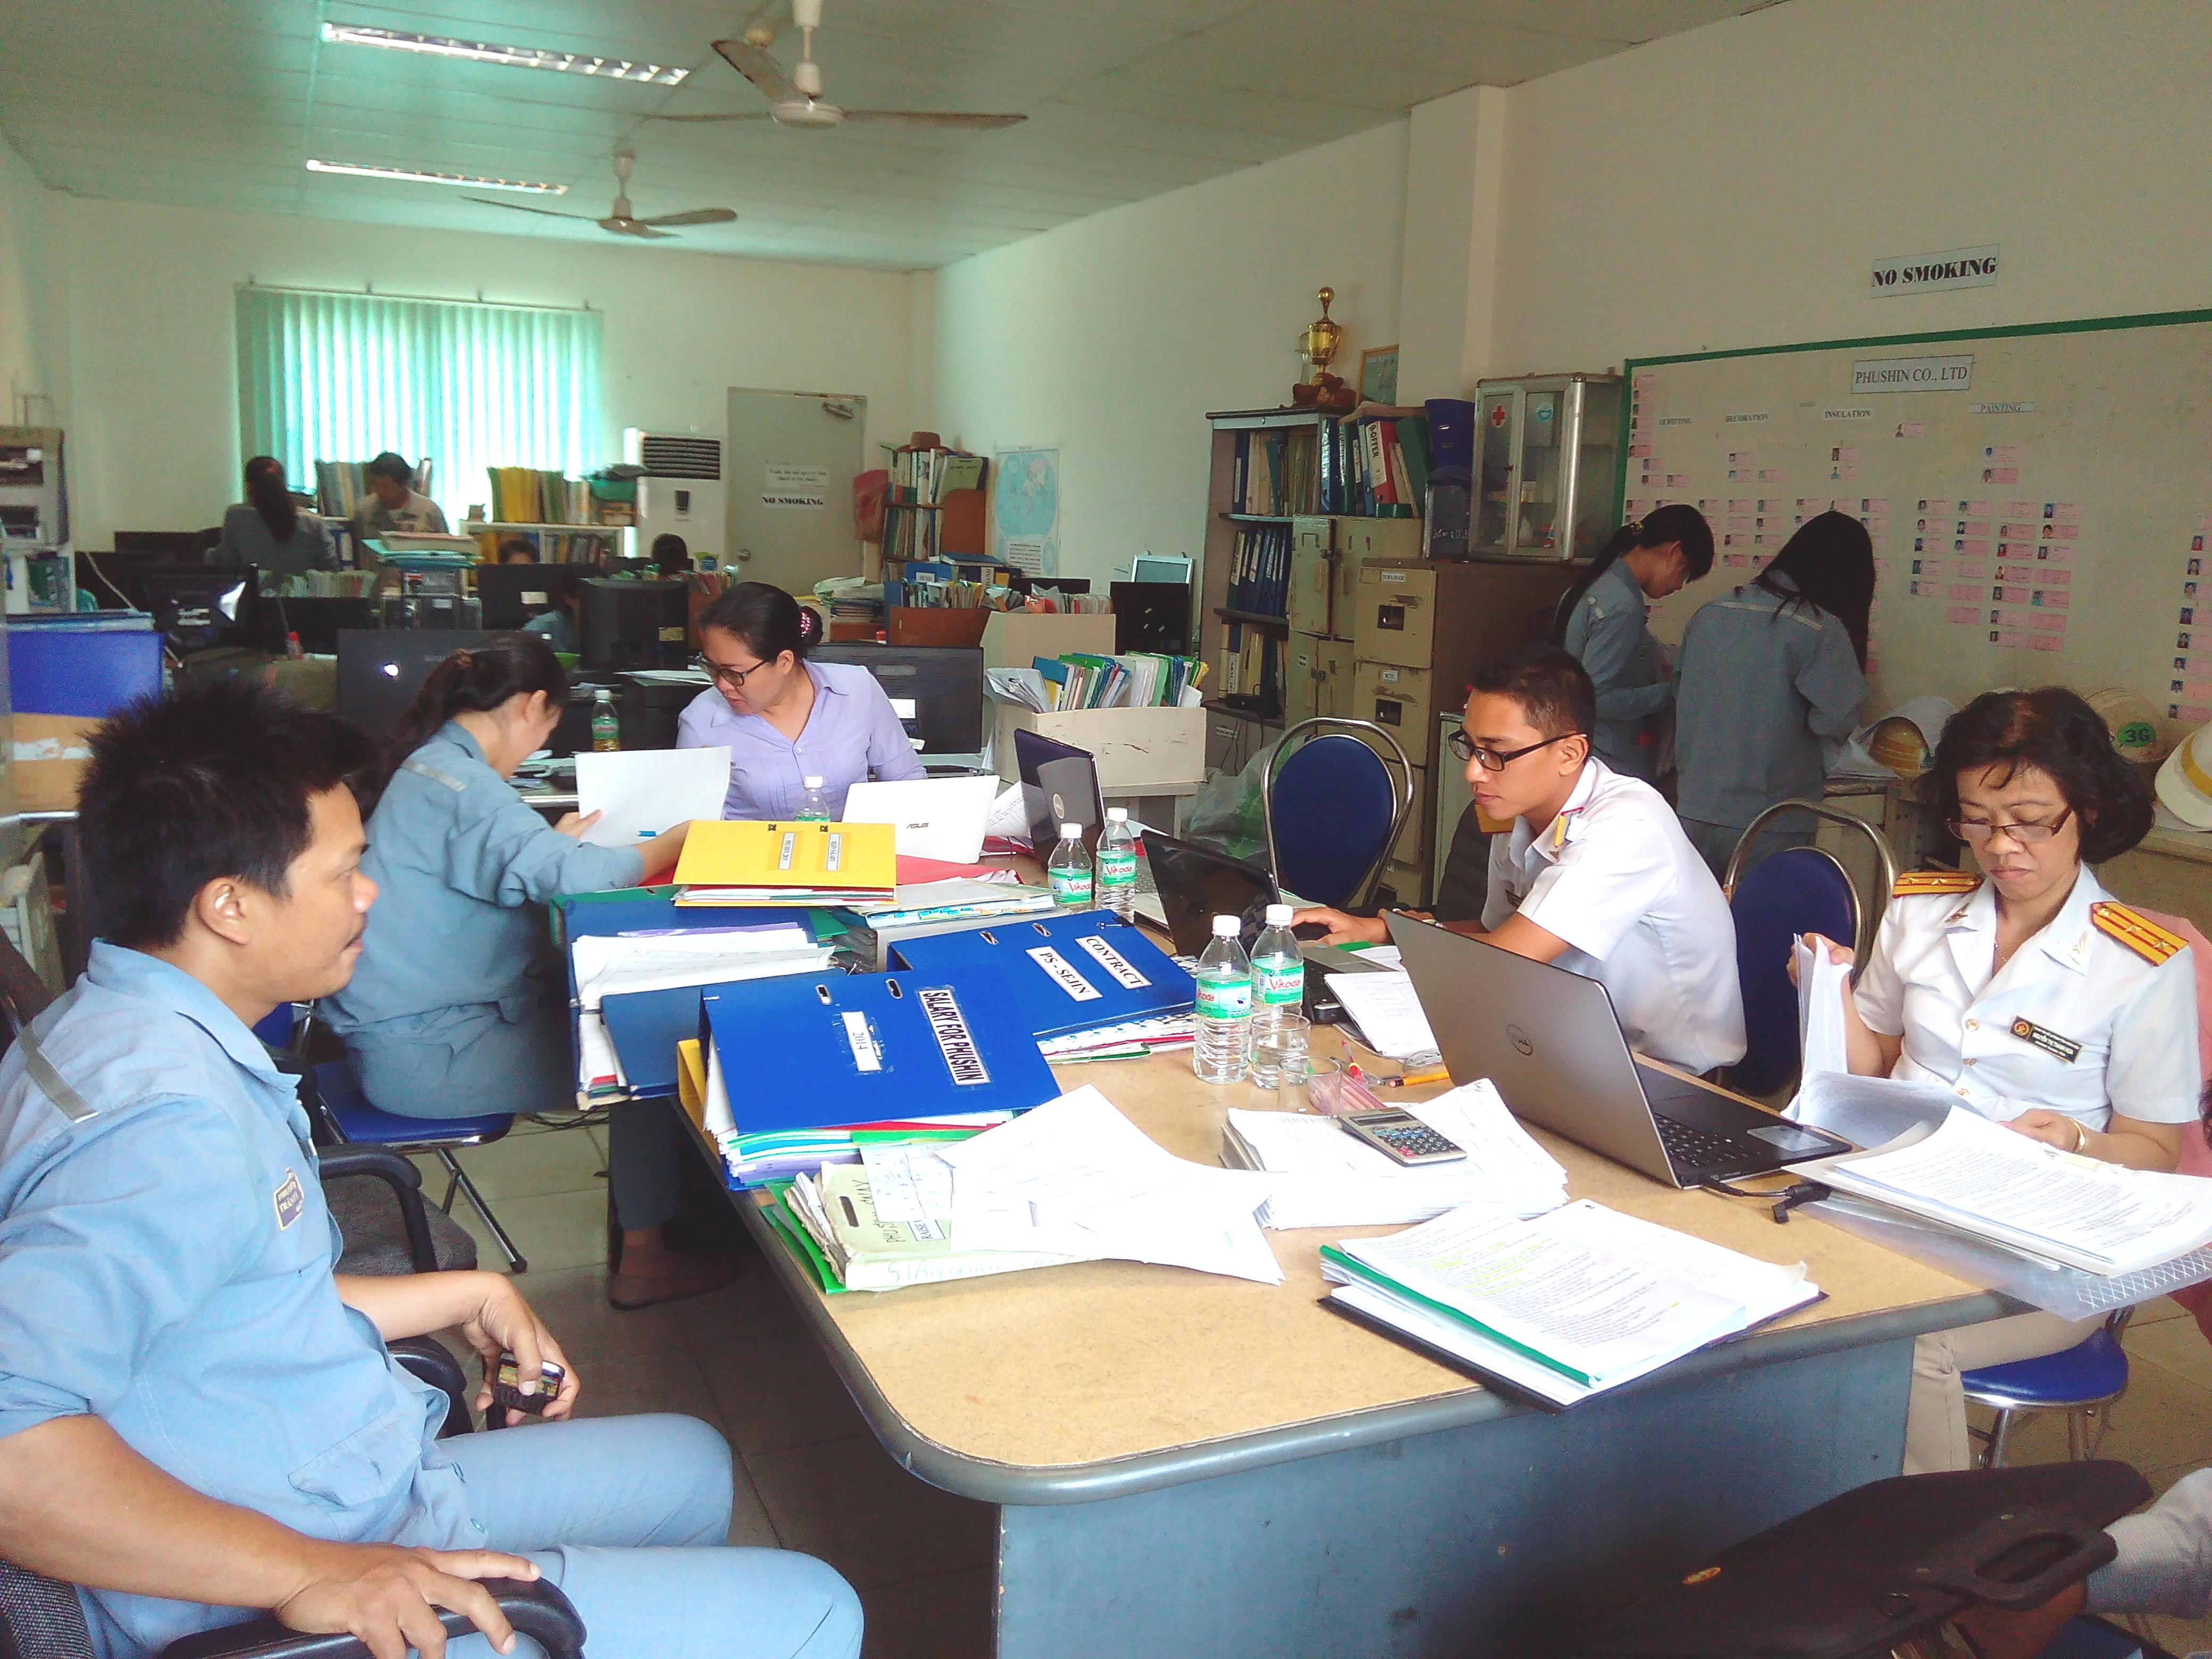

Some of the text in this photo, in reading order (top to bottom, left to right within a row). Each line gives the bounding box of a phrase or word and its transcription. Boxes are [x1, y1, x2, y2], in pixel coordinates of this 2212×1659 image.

[1872, 257, 1997, 287] NO SMOKING
[1855, 370, 1909, 384] PHUSHIN
[1941, 366, 1967, 380] LTD
[1824, 409, 1871, 419] INSULATION
[1980, 404, 2021, 413] PAINTING
[2124, 728, 2150, 742] 3G
[1105, 865, 1133, 876] Vikoda
[1086, 938, 1143, 985] CONTRACT
[1039, 952, 1058, 963] PS
[1057, 969, 1091, 994] SEJIN
[1269, 978, 1301, 992] Vikoda
[852, 1032, 868, 1050] 2014
[923, 992, 985, 1080] SALARY FOR PHUSHIN
